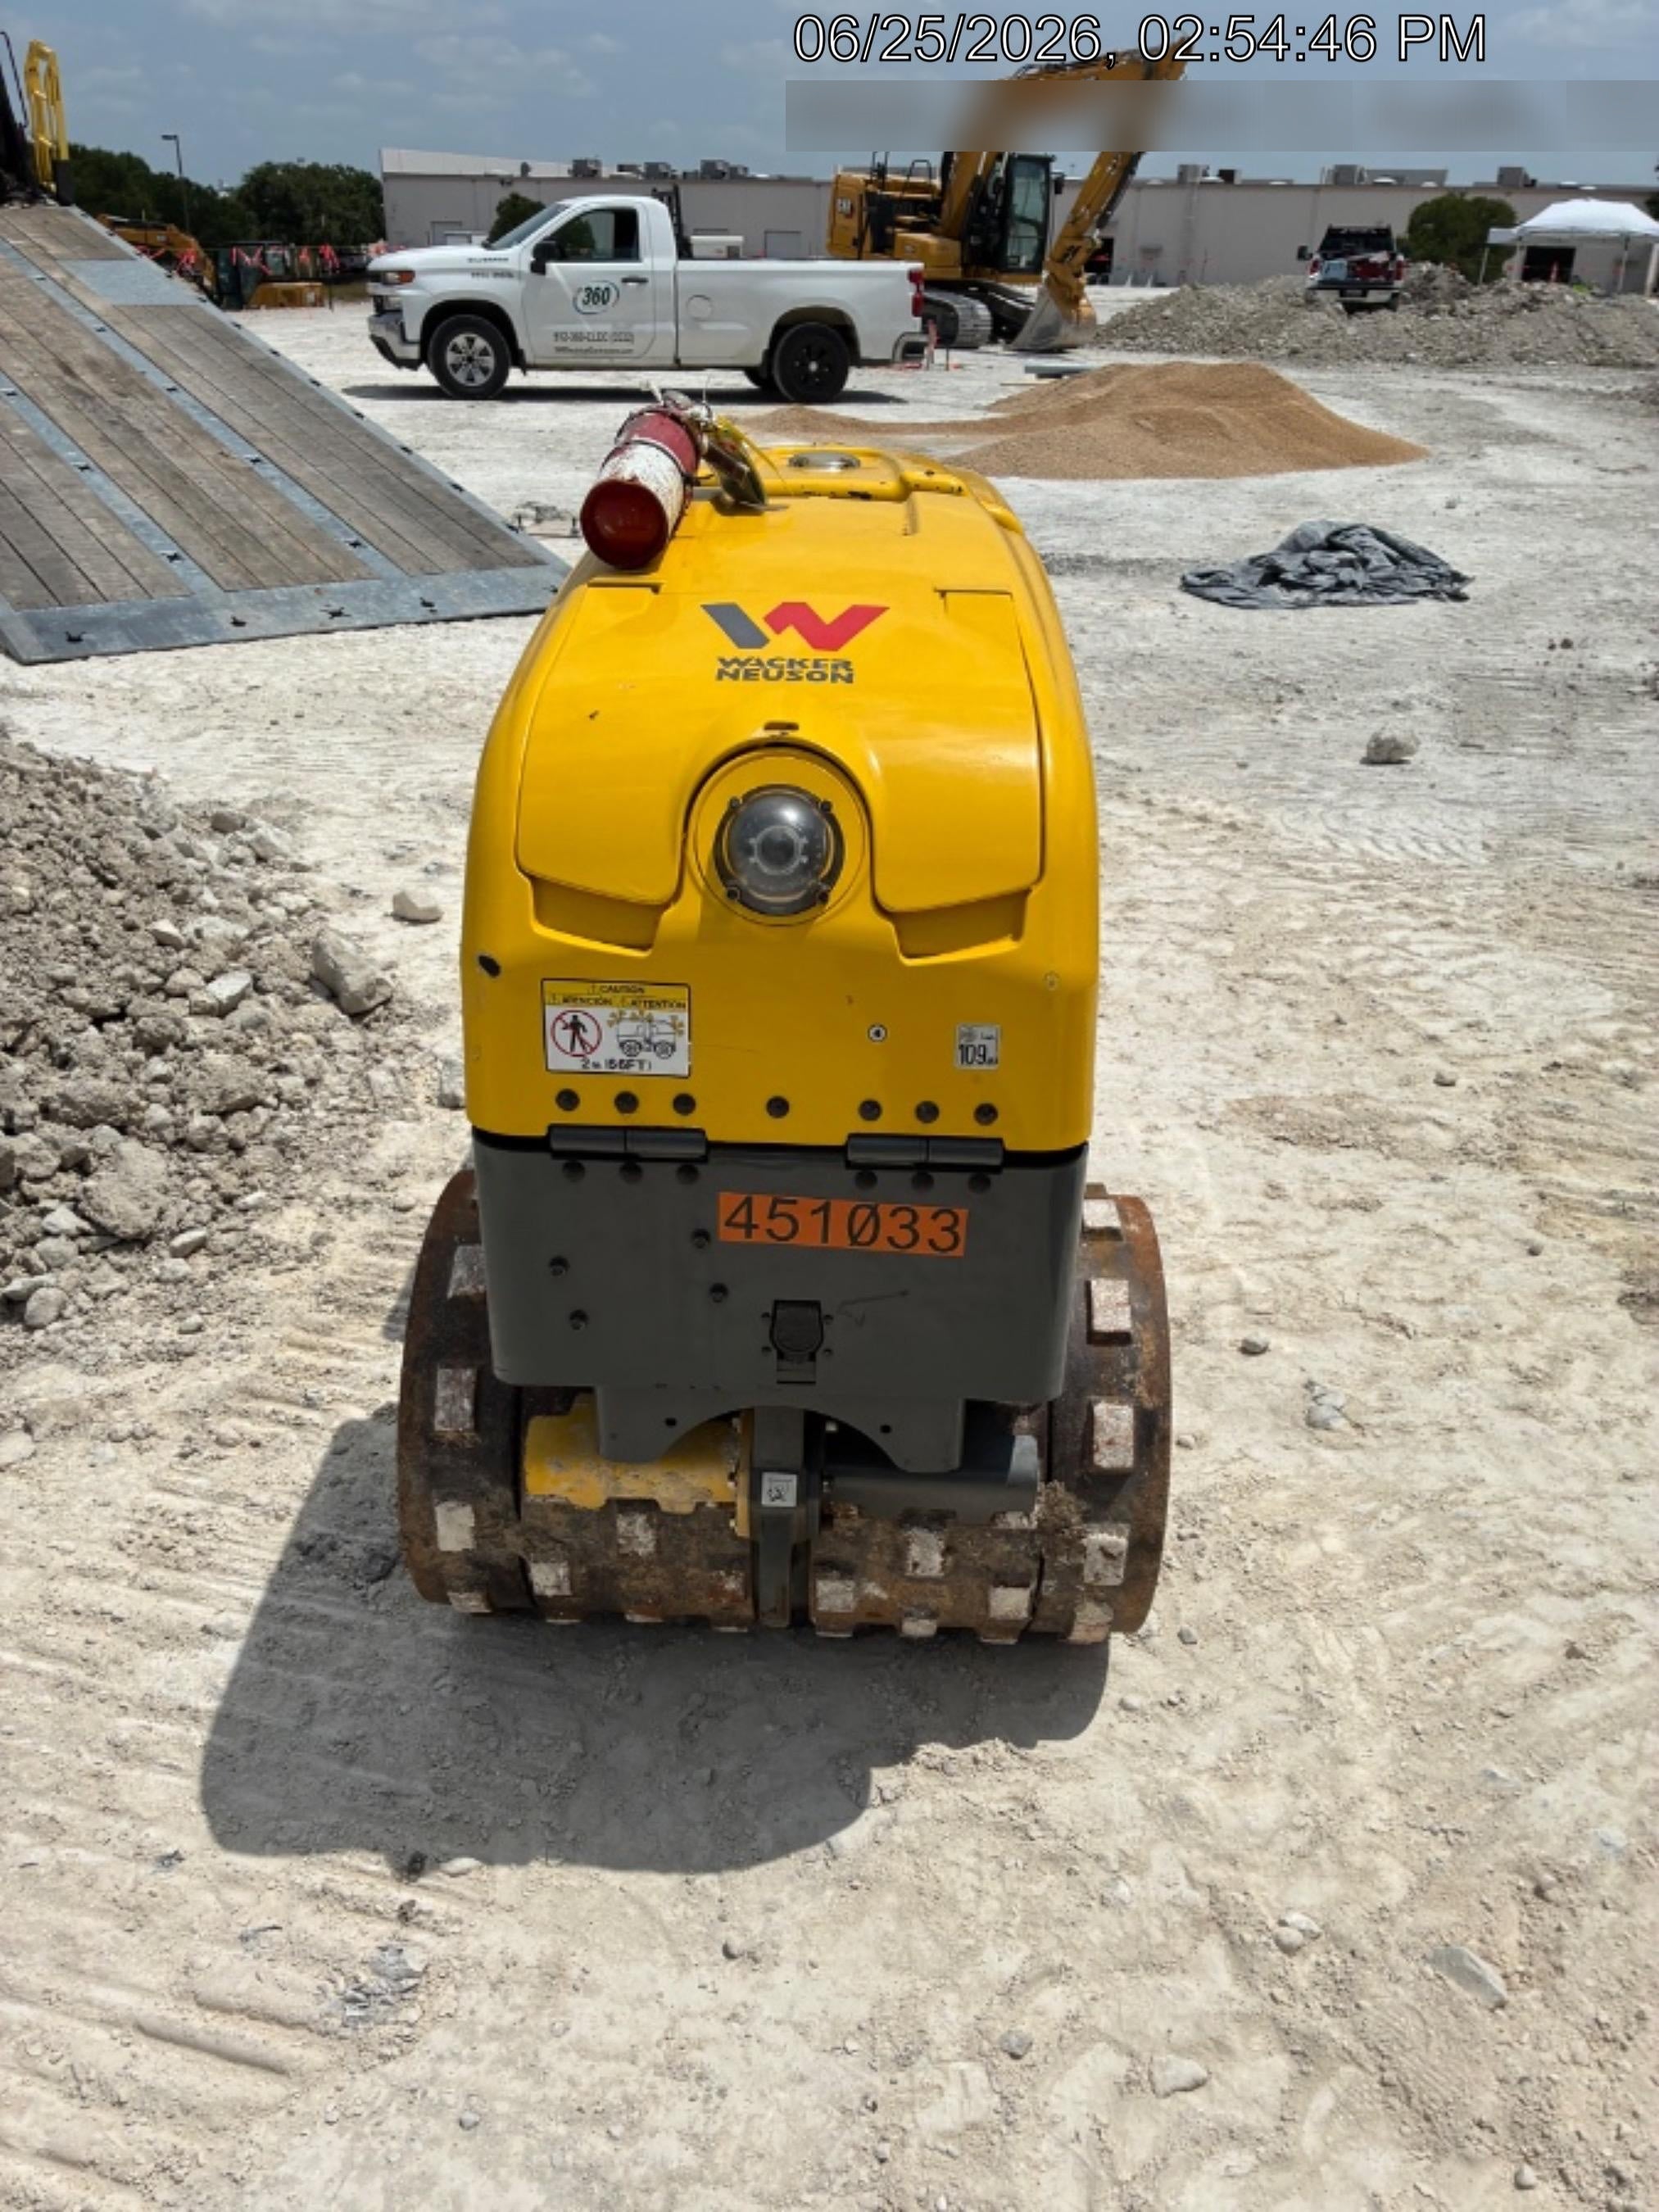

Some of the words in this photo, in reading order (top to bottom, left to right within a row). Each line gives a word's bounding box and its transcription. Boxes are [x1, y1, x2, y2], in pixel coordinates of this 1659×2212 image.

[582, 286, 611, 306] 360
[717, 656, 853, 672] WACKER
[714, 668, 854, 684] NEUSON
[599, 984, 645, 994] CAUTION
[630, 998, 687, 1009] ATTENTION
[959, 1044, 986, 1065] 109
[723, 1195, 962, 1253] 451033
